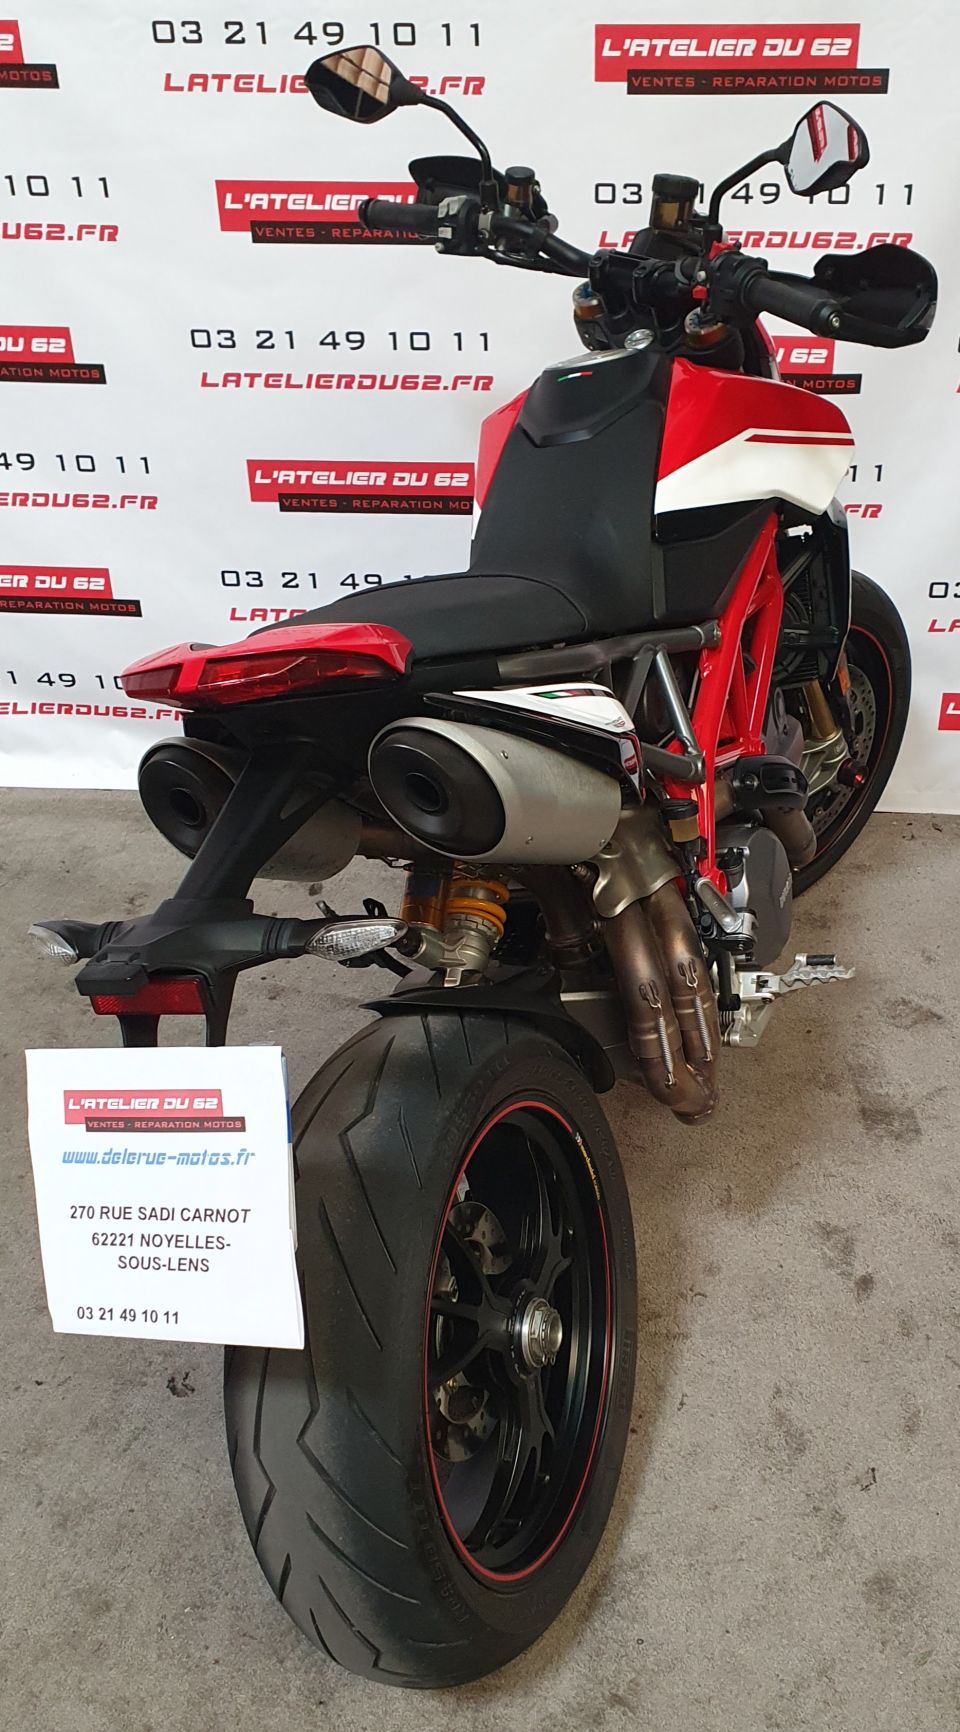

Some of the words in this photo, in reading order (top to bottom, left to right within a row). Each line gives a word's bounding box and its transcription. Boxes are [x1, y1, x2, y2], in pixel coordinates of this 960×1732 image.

[151, 20, 202, 44] 03
[224, 21, 267, 45] 21
[294, 21, 344, 46] 49
[369, 22, 416, 46] 10
[441, 22, 480, 47] 11
[602, 38, 756, 57] L'ATELIER
[762, 38, 804, 57] DU
[810, 38, 852, 56] 62
[631, 76, 695, 87] VENTES
[713, 76, 817, 87] REPARATION
[824, 75, 882, 87] MOTOS
[4, 175, 50, 197] 10
[71, 176, 109, 198] 11
[594, 183, 643, 204] 03
[731, 182, 781, 205] 49
[876, 183, 913, 205] 11
[256, 227, 315, 238] VENTES
[31, 337, 66, 353] 62
[190, 329, 237, 349] 03
[256, 330, 295, 349] 21
[319, 331, 366, 350] 49
[388, 332, 431, 351] 10
[453, 332, 489, 351] 11
[789, 348, 829, 363] 62
[49, 368, 100, 379] MOTOS
[200, 372, 494, 391] LATELIERDU62.FR
[802, 379, 856, 389] MOTOS
[56, 454, 96, 472] 10
[115, 456, 150, 474] 11
[255, 469, 387, 486] L'ATELIER
[392, 472, 428, 486] DU
[433, 472, 470, 487] 62
[282, 498, 338, 508] VENTES
[353, 500, 443, 509] REPARATION
[35, 576, 67, 589] DU
[73, 577, 105, 590] 62
[221, 570, 264, 588] 03
[281, 572, 317, 589] 21
[90, 603, 137, 612] MOTOS
[37, 672, 76, 687] 49
[68, 1097, 159, 1110] L'ATELIER
[163, 1097, 190, 1110] DU
[193, 1097, 219, 1109] 62
[87, 1121, 125, 1129] VENTES
[134, 1121, 200, 1129] REPARATION
[203, 1121, 242, 1129] MOTOS
[62, 1148, 256, 1166] www.delerue-motos.fr
[70, 1206, 95, 1220] 270
[99, 1206, 133, 1220] RUE
[137, 1207, 175, 1221] SADI
[180, 1208, 251, 1224] CARNOT
[91, 1232, 134, 1247] 62221
[140, 1233, 231, 1250] NOYELLES-
[117, 1255, 210, 1272] SOUS-LENS
[77, 1306, 94, 1320] 03
[99, 1307, 113, 1321] 21
[119, 1308, 137, 1322] 49
[142, 1309, 159, 1323] 10
[163, 1311, 180, 1325] 11
